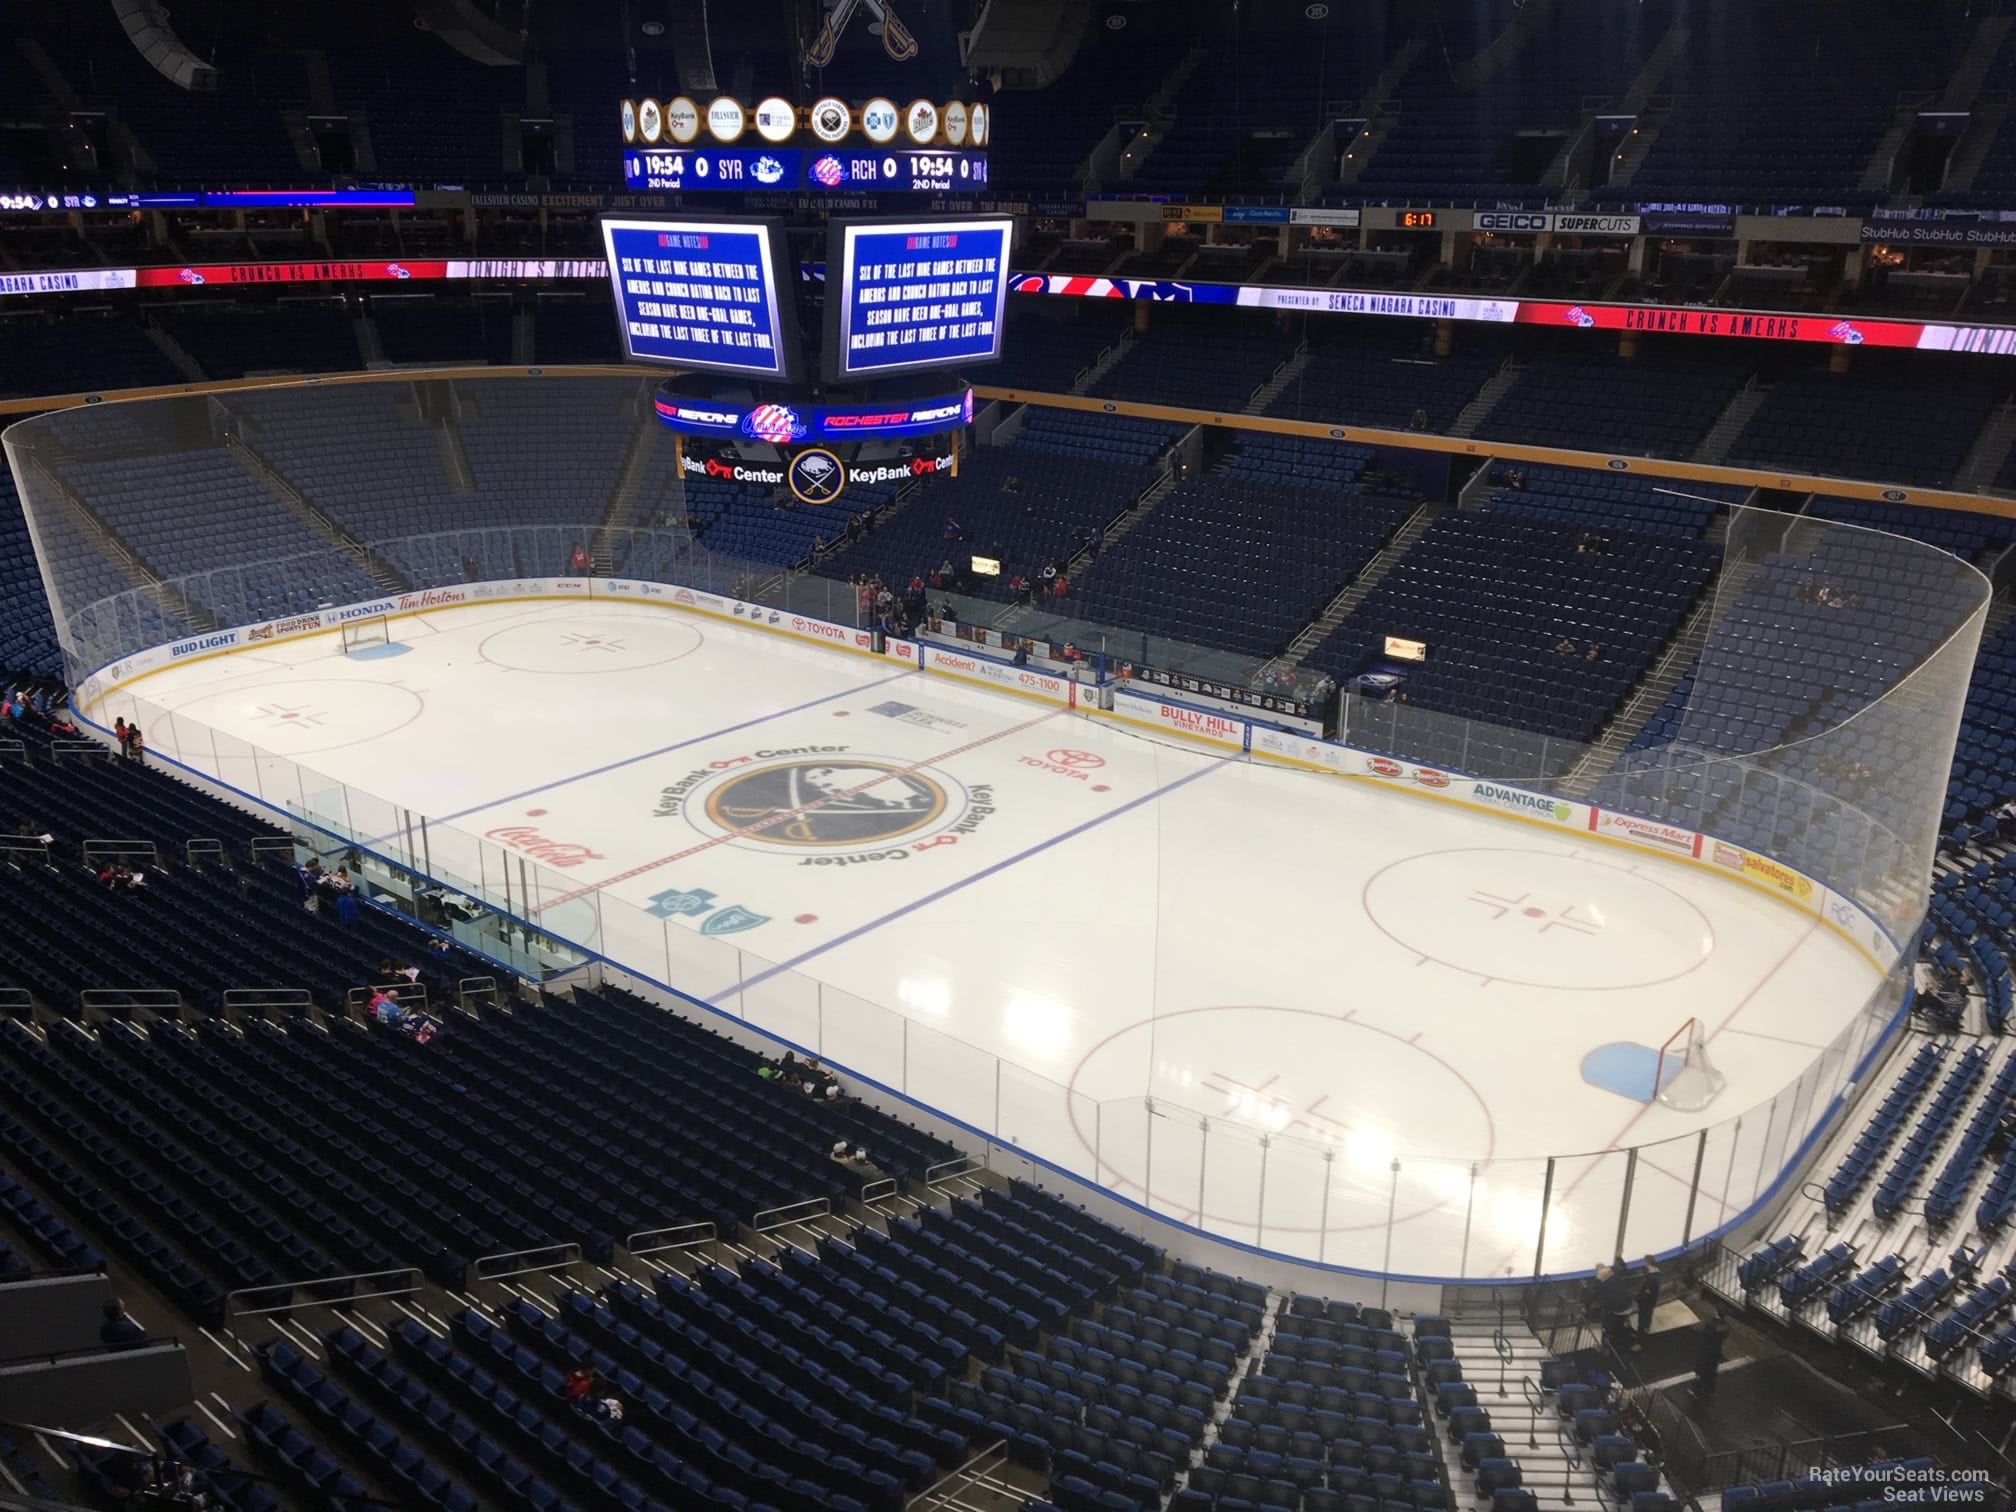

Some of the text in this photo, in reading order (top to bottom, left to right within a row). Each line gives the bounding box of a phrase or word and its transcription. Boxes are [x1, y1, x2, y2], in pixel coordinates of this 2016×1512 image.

[671, 111, 696, 121] KeyBank
[645, 156, 684, 175] 19:54
[695, 157, 709, 177] 0
[718, 160, 743, 179] SYR
[852, 160, 877, 180] RCH
[883, 157, 897, 178] 0
[910, 156, 953, 176] 19:54
[661, 178, 680, 188] Period
[913, 180, 950, 190] 2ND Period
[48, 196, 58, 208] 0
[511, 195, 538, 206] CASINO
[542, 195, 604, 206] EXCITEMENT
[612, 195, 635, 207] JUST
[640, 196, 665, 207] OVER
[1404, 213, 1432, 227] 6:17
[1480, 214, 1546, 229] GEICO
[1559, 216, 1632, 231] SUPERCUTS
[666, 235, 700, 249] GAME NOTES
[915, 235, 950, 249] GAME NOTES
[1862, 226, 1910, 240] StubHub
[1913, 228, 1963, 241] StubHub
[231, 263, 364, 282] CRUNCH VS AMERKS
[40, 275, 79, 290] CASINO
[1277, 295, 1310, 306] PRESENTED
[1328, 293, 1365, 313] SENECA
[1370, 295, 1413, 315] NIAGARA
[1418, 297, 1456, 317] CASINO
[1626, 310, 1799, 338] CRUNCH VS AMERKS
[824, 412, 909, 427] ROCHESTER
[681, 456, 784, 484] eyBank Center
[850, 464, 912, 484] KeyBank
[397, 591, 465, 611] Tim Hortons
[339, 602, 395, 620] HONDA
[276, 620, 297, 629] FOOD
[302, 620, 321, 631] FUN
[807, 621, 846, 641] TOYOTA
[172, 633, 236, 657] BUD LIGHT
[934, 653, 976, 672] Accident?
[1018, 673, 1060, 692] 475-1100
[1160, 705, 1237, 735] BULLY HILL
[1173, 719, 1224, 738] VINEYARDS
[1016, 755, 1091, 781] TOYOTA
[653, 745, 850, 818] KeyBank Center
[1473, 783, 1555, 812] ADVANTAGE
[798, 784, 996, 867] KeyBank Center
[1614, 816, 1693, 843] Express Mart
[484, 826, 607, 868] Coca-Cola
[1744, 855, 1795, 886] salvatores
